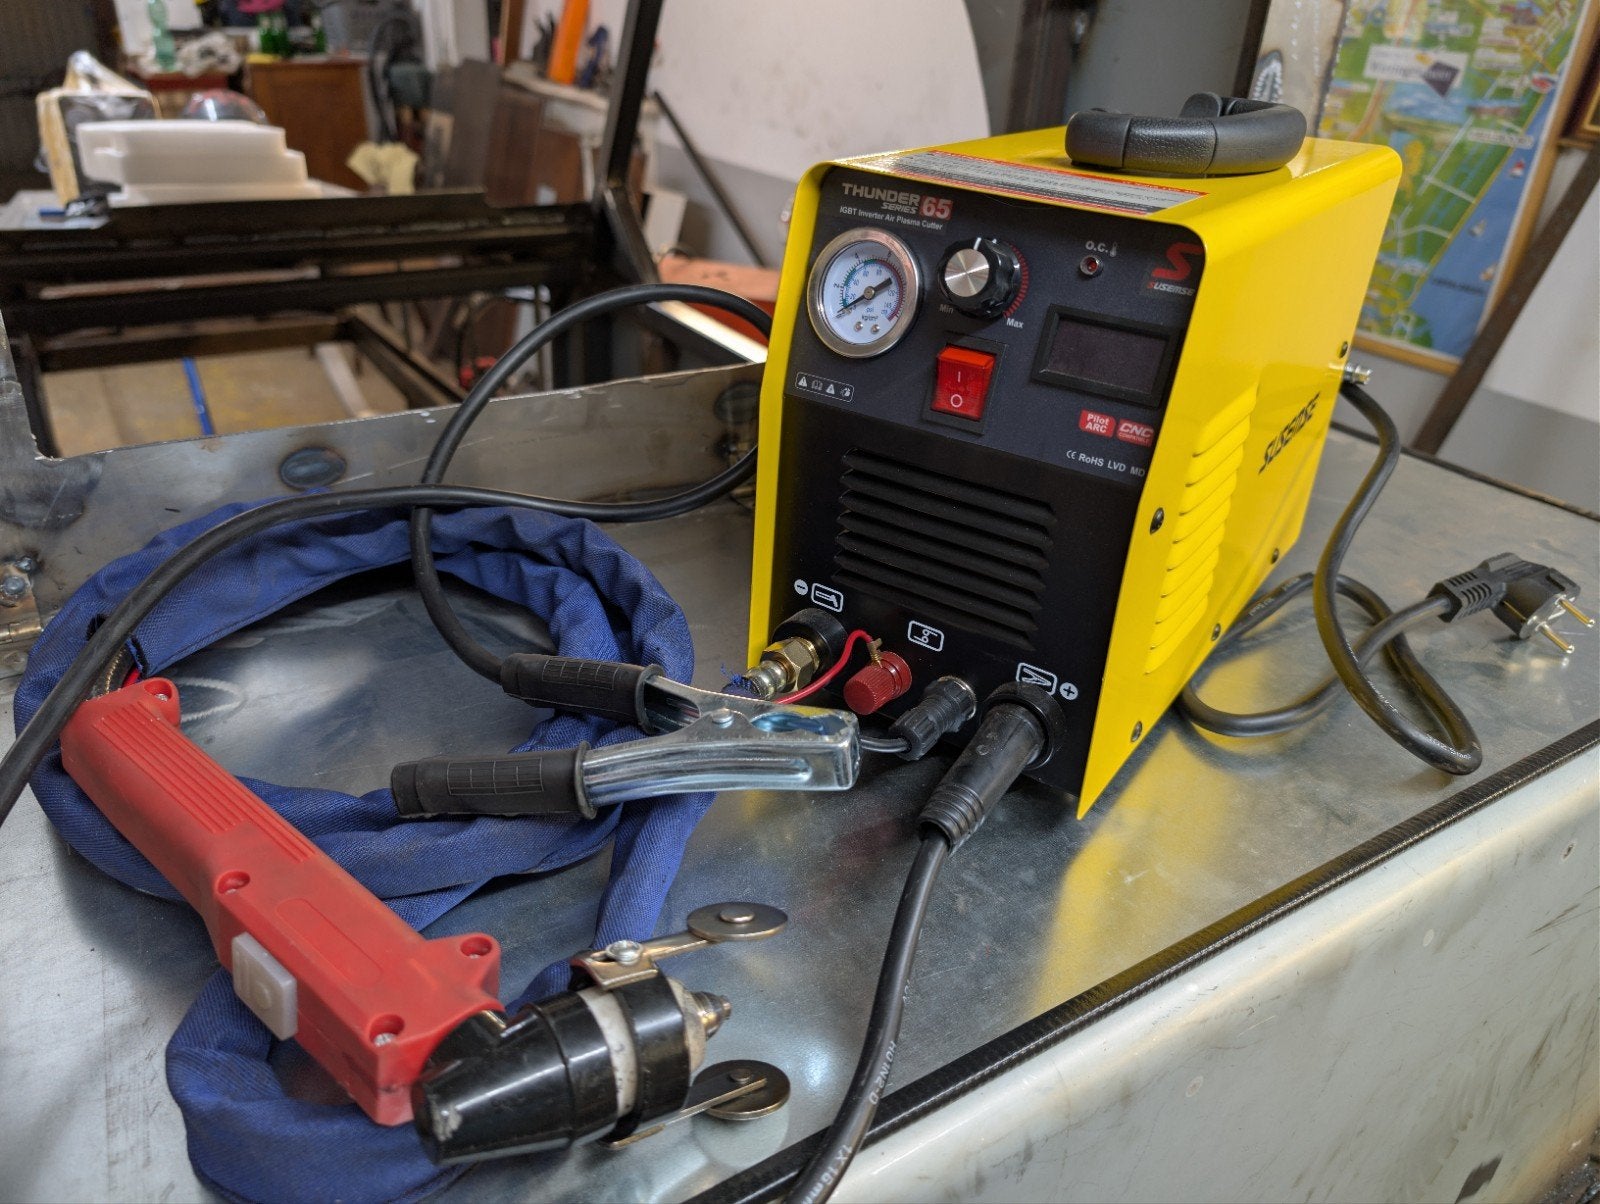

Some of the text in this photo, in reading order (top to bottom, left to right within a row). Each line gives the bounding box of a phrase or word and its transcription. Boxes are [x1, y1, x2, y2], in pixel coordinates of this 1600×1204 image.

[842, 183, 920, 207] THUNDER
[881, 201, 919, 215] SERIES
[922, 196, 953, 220] 65
[840, 206, 944, 231] IGBT Inverter Air Plasma Cutter
[940, 304, 954, 314] Min
[1006, 318, 1024, 329] Max
[1087, 413, 1110, 426] Pilot
[1085, 422, 1107, 433] ARC
[1119, 422, 1154, 438] CNC
[1078, 453, 1105, 467] RoHS
[1107, 460, 1127, 472] LVD
